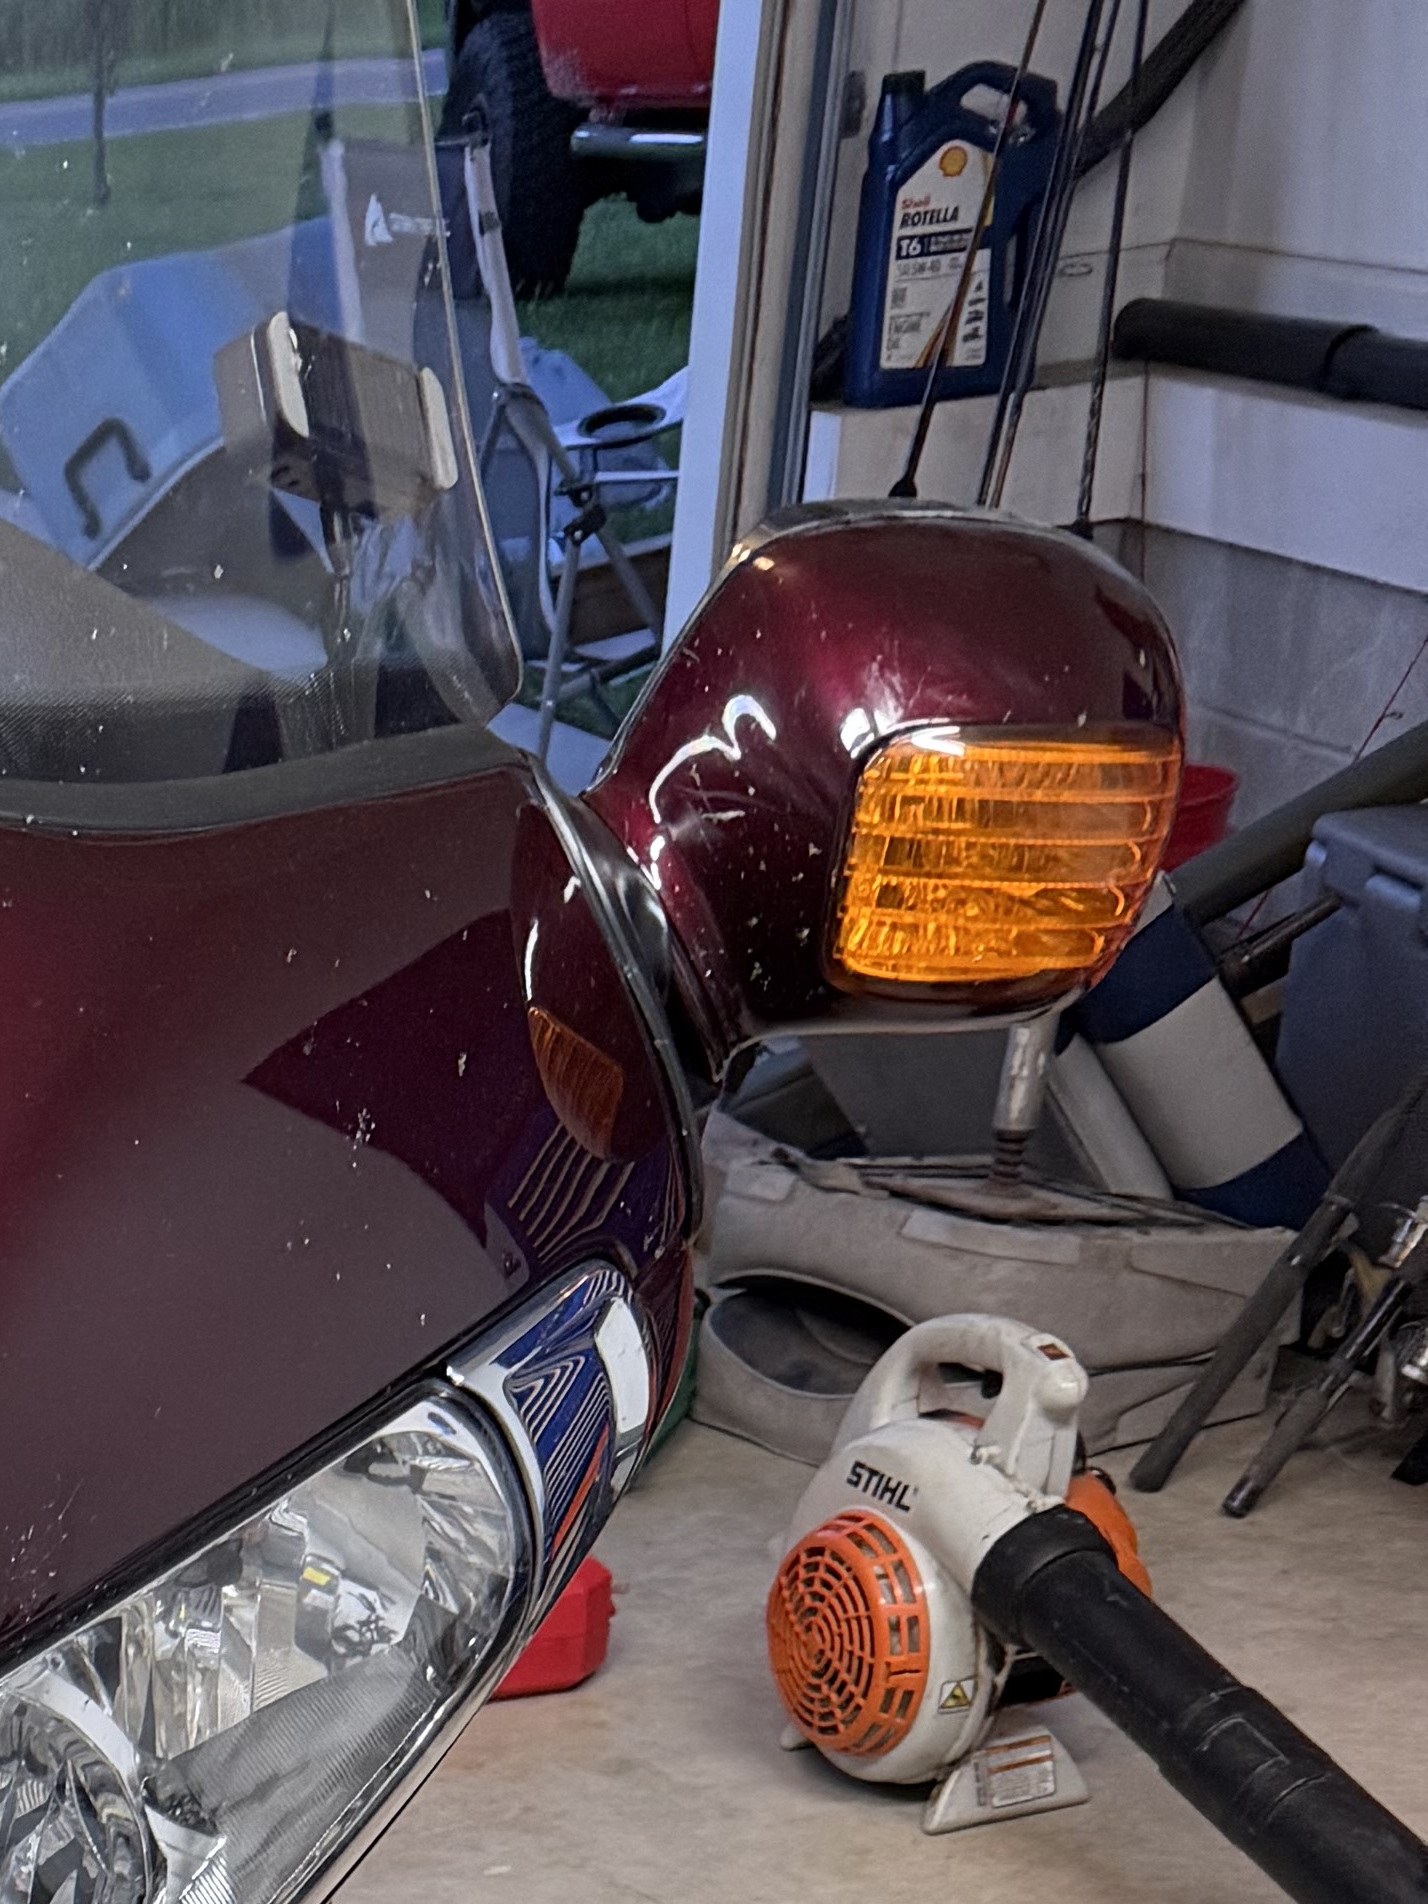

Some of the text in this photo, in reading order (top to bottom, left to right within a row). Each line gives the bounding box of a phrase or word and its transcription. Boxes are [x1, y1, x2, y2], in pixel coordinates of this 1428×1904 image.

[900, 205, 960, 229] ROTELLA
[900, 238, 922, 257] T6
[846, 1460, 911, 1513] STIHL
